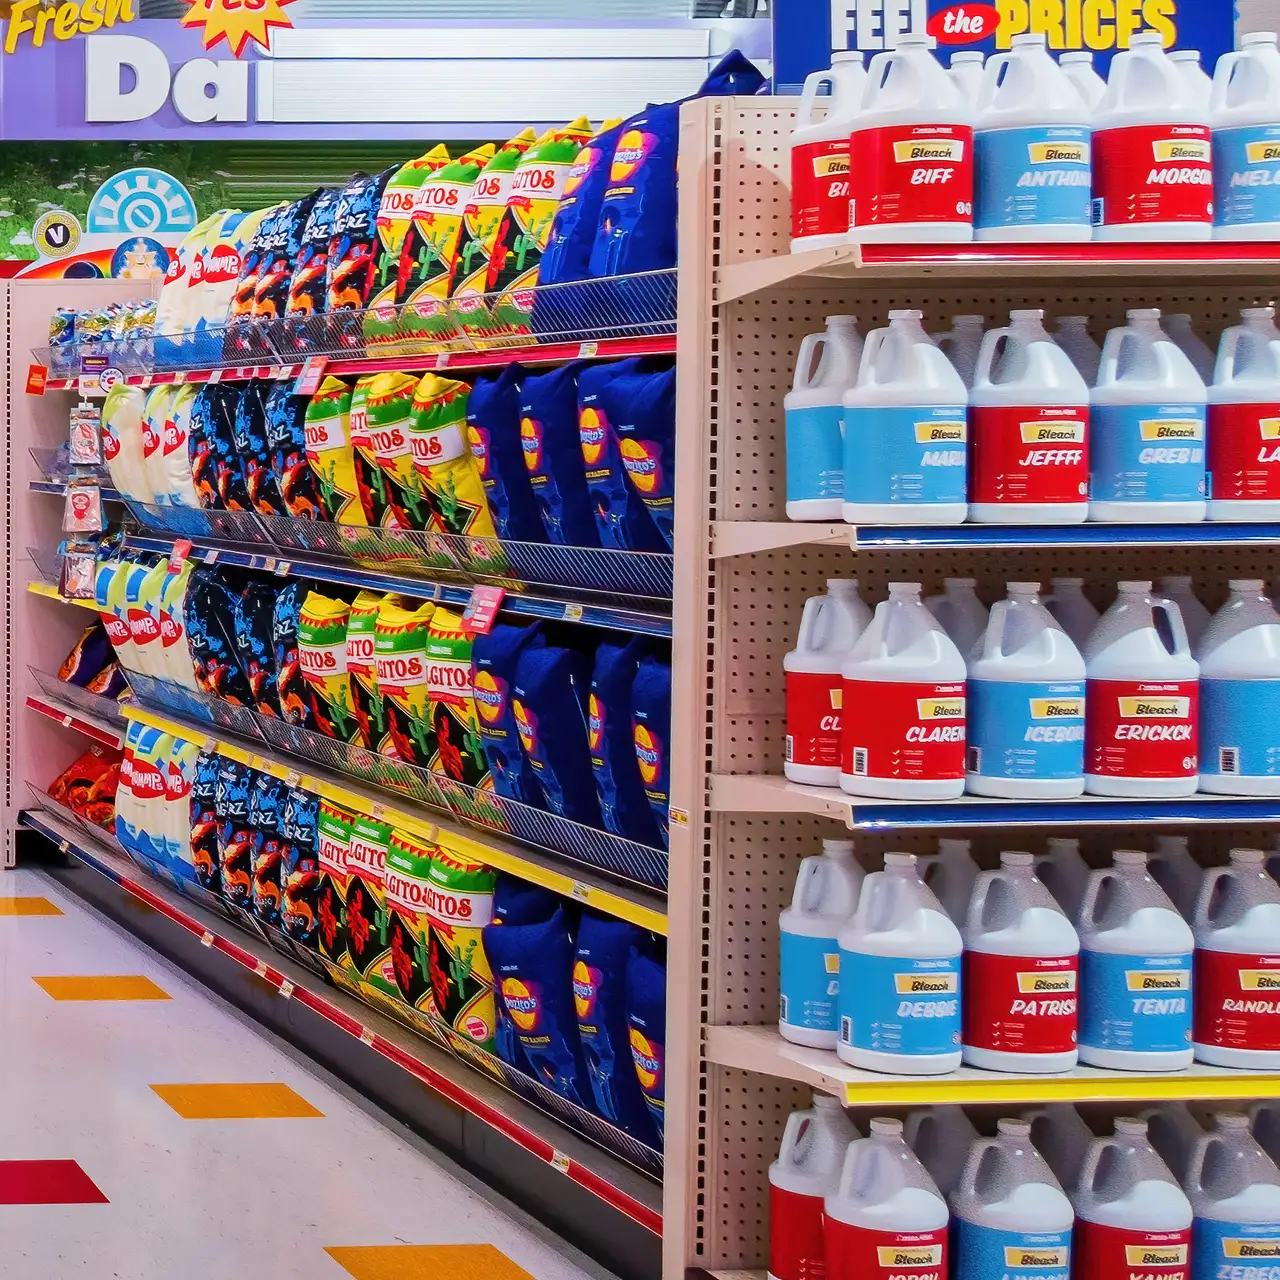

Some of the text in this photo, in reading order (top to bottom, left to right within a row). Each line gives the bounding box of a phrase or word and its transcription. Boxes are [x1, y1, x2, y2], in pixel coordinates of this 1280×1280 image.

[943, 10, 983, 34] the
[911, 147, 952, 159] Bleach
[1045, 149, 1081, 160] Bleach
[911, 168, 954, 185] BIFF
[1037, 429, 1076, 440] Bleach
[1156, 427, 1195, 438] Bleach
[1135, 704, 1178, 715] Bleach
[911, 980, 949, 992] Bleach
[1142, 978, 1181, 989] Bleach
